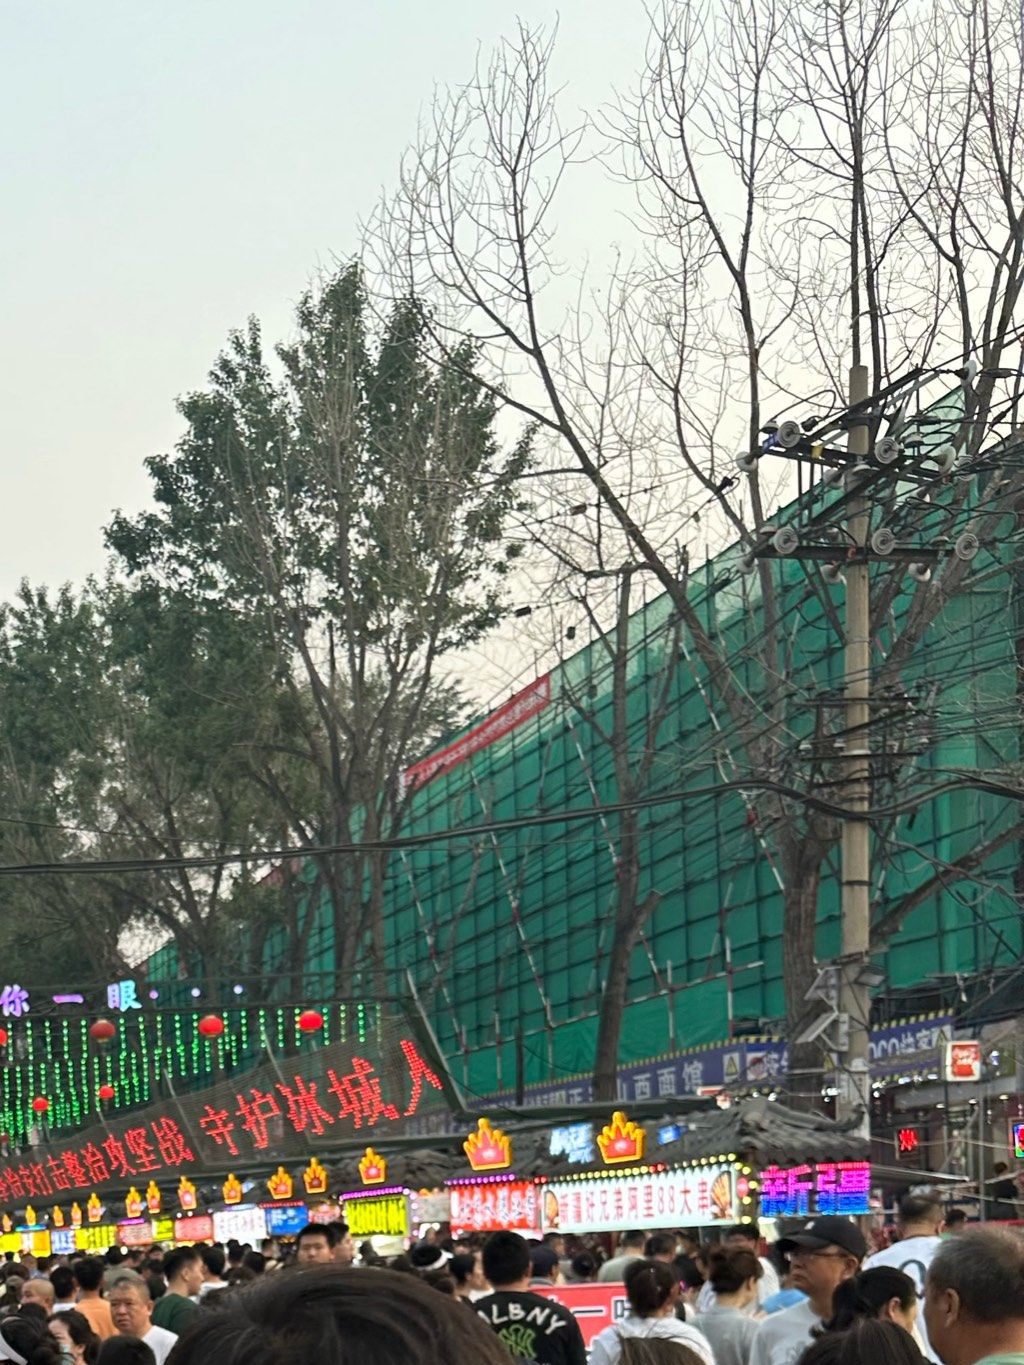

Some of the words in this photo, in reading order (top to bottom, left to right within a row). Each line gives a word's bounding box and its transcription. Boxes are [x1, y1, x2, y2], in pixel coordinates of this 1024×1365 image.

[199, 1039, 444, 1156] 守护冰城人
[759, 1161, 871, 1217] 新疆
